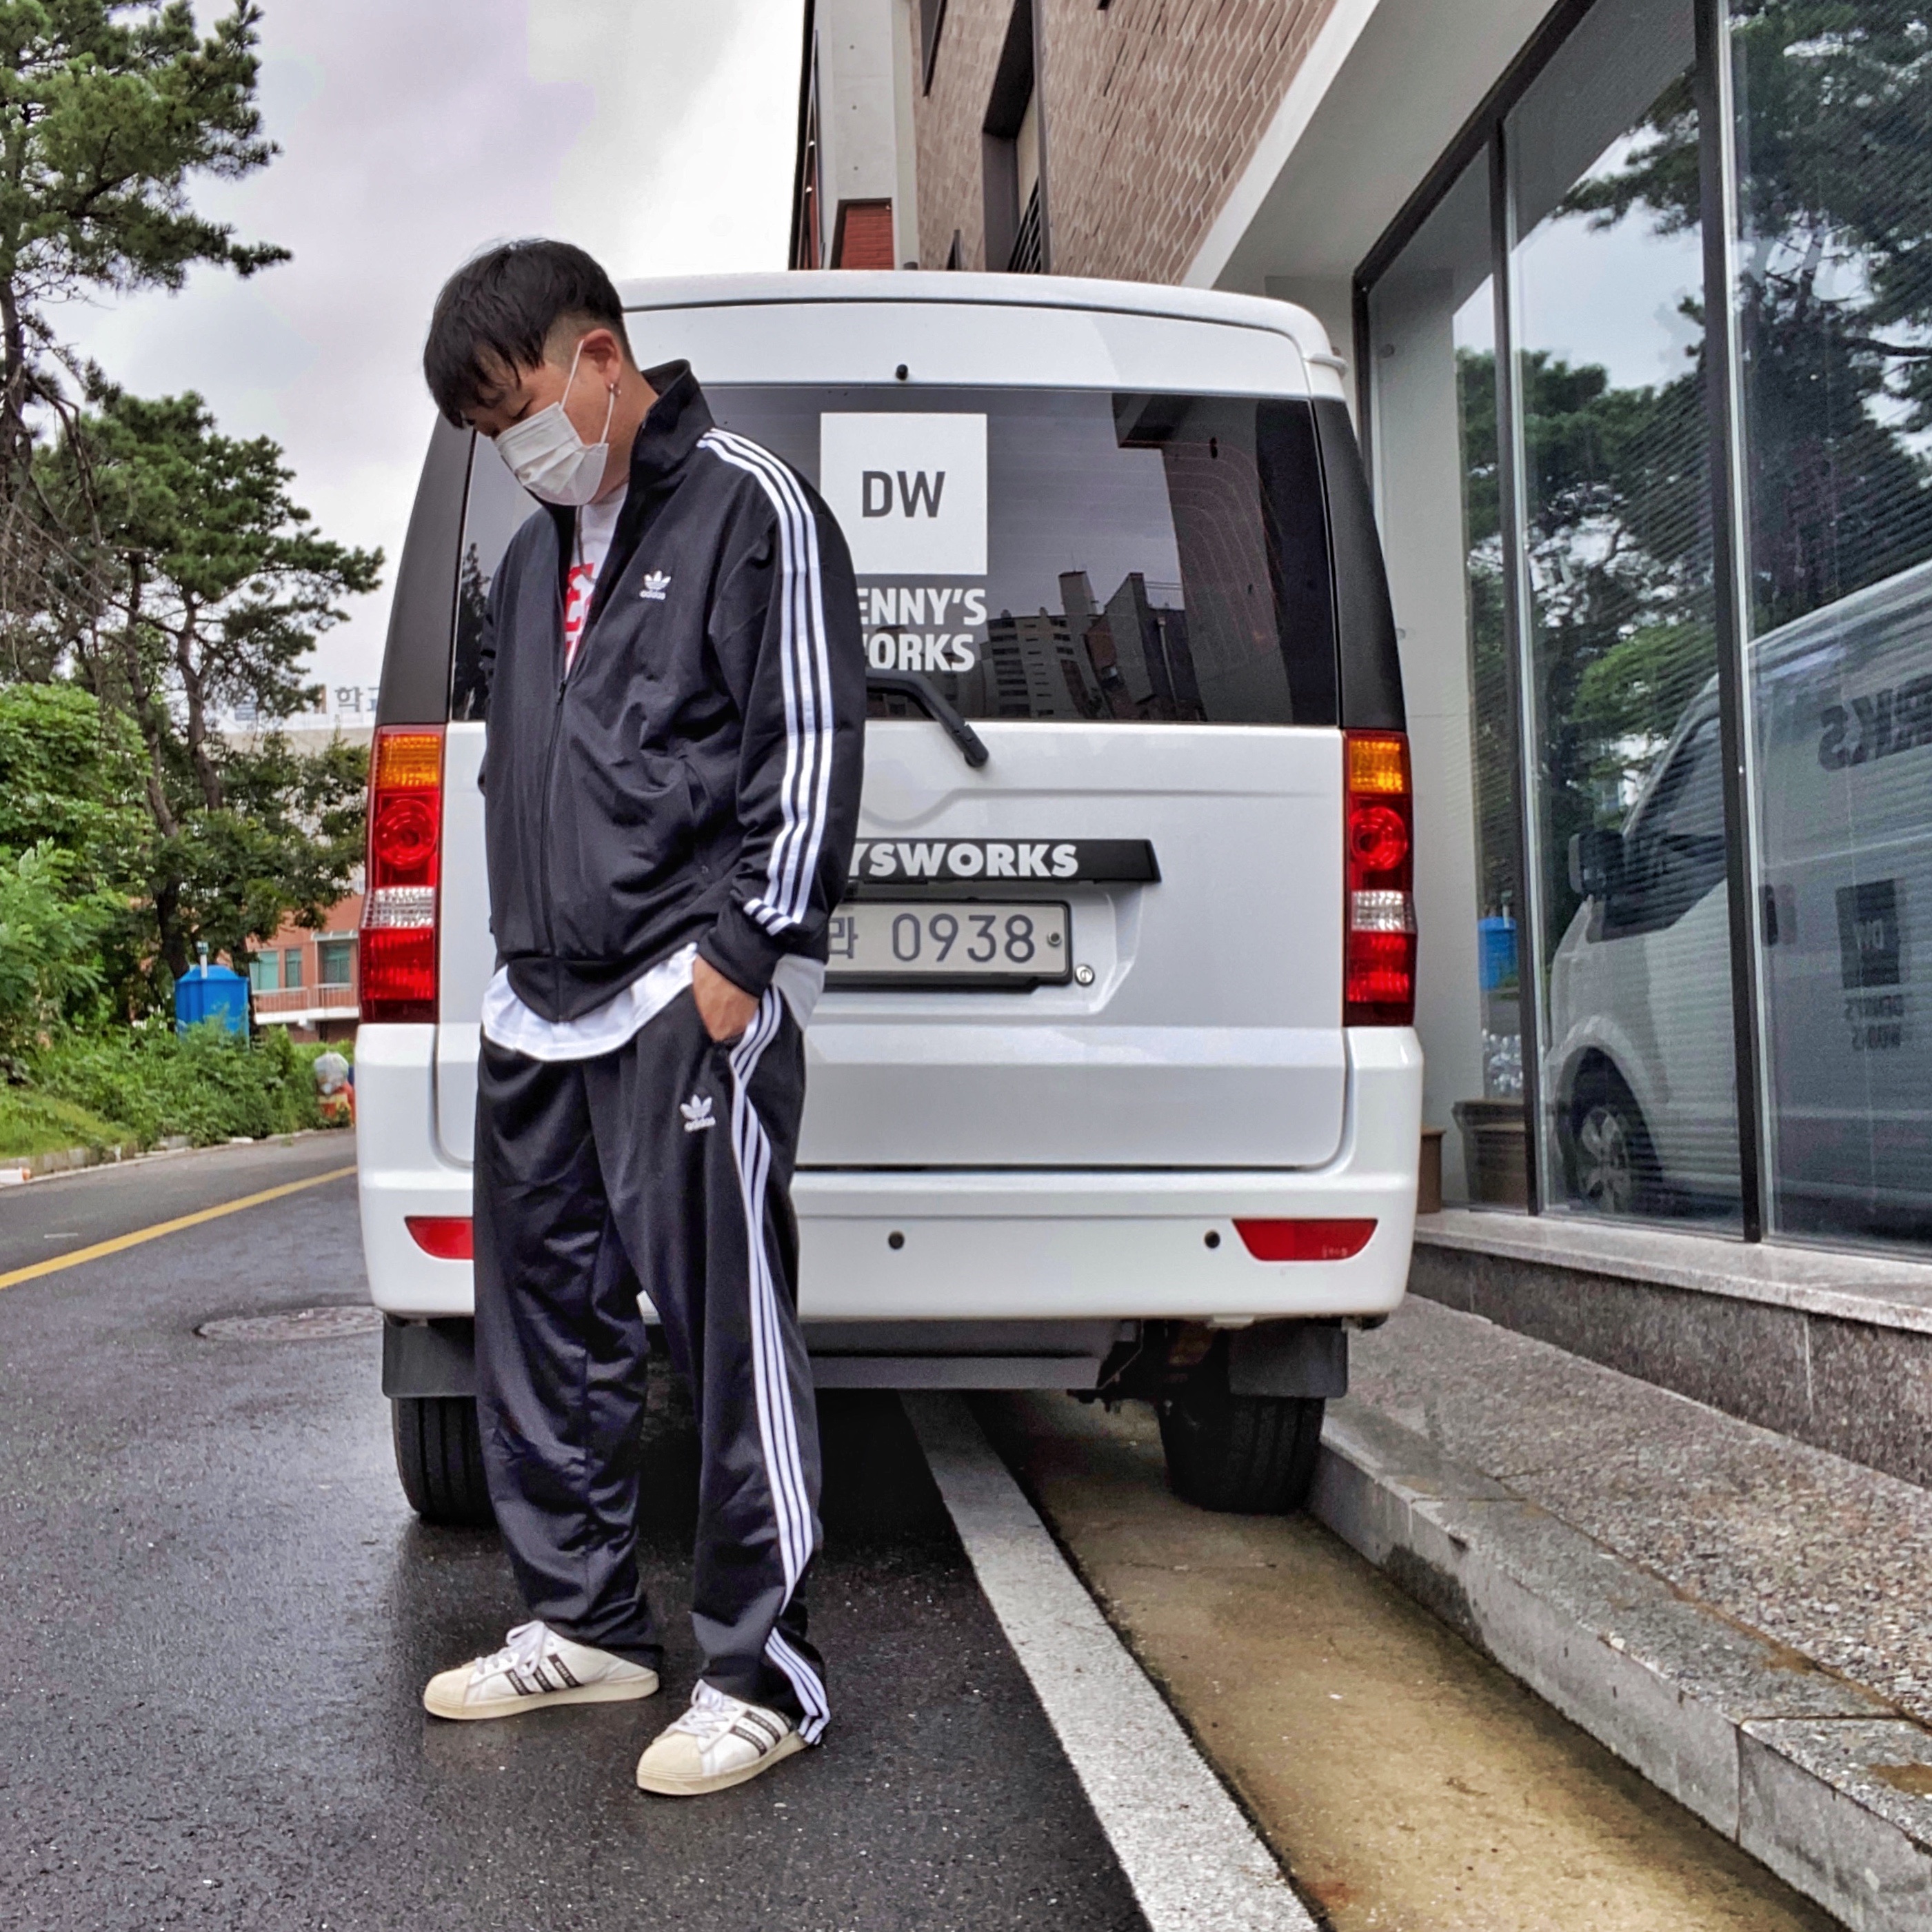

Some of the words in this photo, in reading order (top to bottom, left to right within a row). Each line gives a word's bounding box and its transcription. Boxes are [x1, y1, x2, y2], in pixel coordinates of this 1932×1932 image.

[862, 470, 945, 518] DW
[863, 633, 975, 672] ORKS
[892, 913, 1035, 964] 0938
